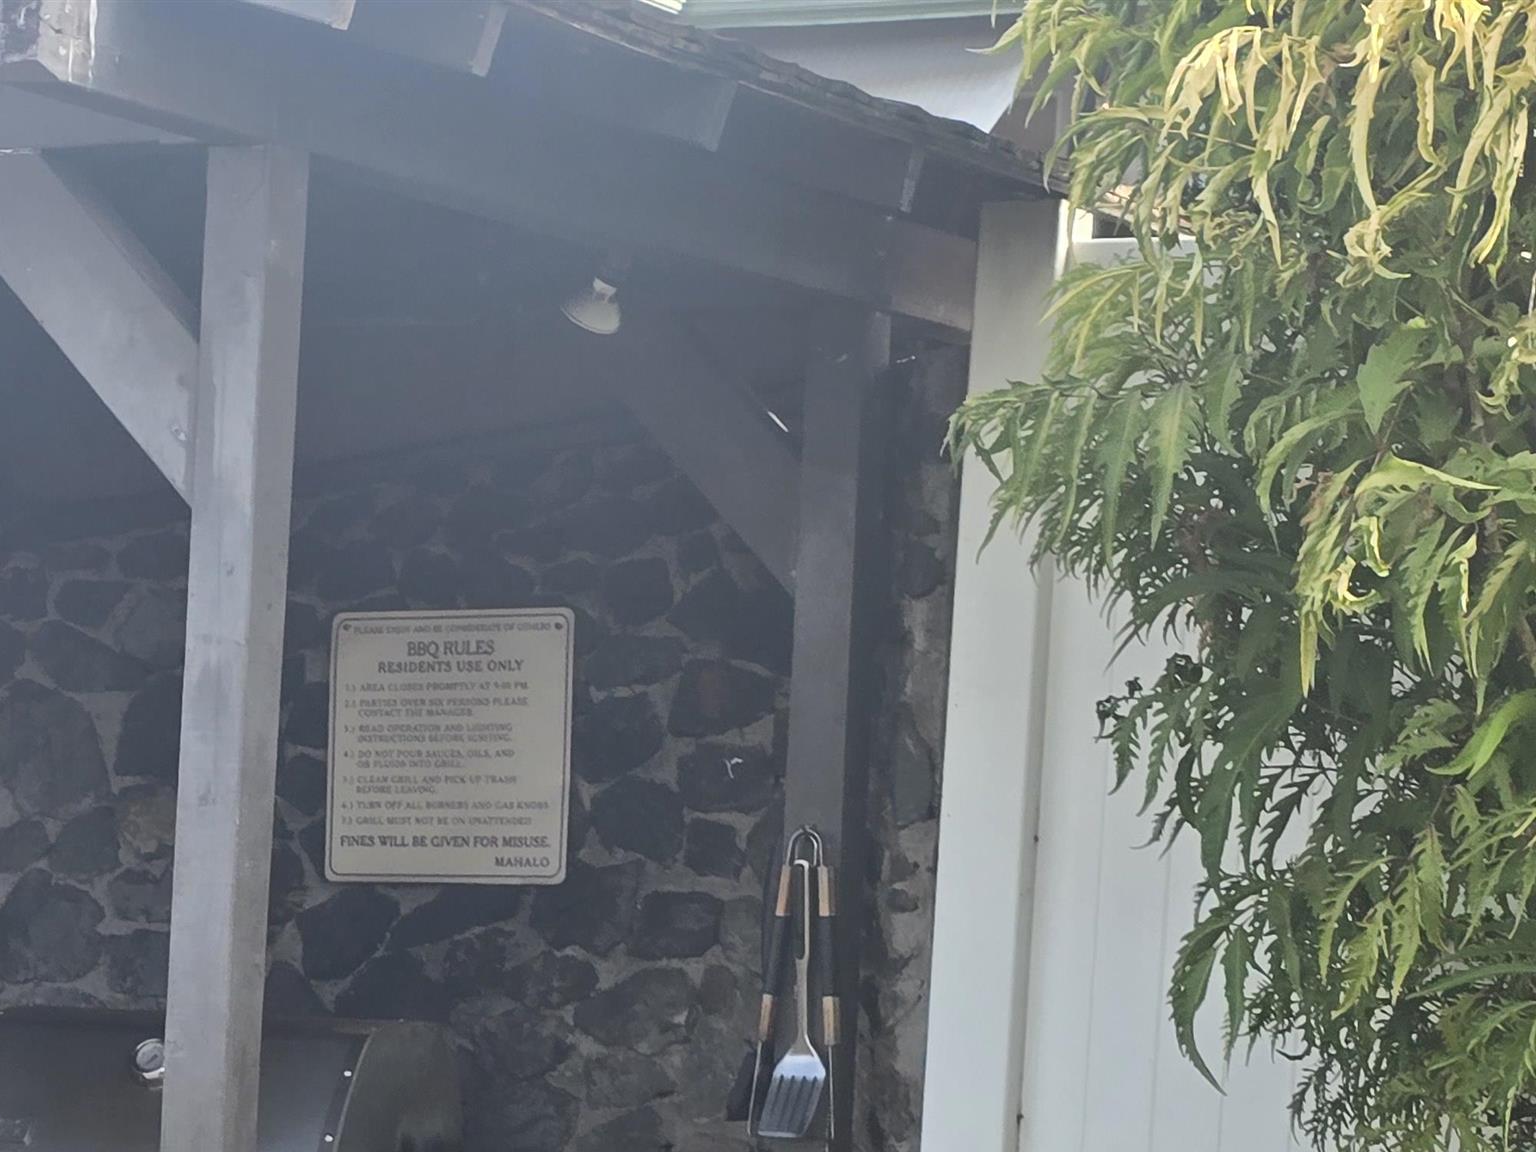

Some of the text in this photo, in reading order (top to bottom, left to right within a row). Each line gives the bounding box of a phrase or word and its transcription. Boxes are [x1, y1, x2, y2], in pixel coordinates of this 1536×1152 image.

[407, 639, 494, 658] BBQ RULES
[378, 659, 524, 673] RESIDENTS USE ONLY
[492, 697, 528, 705] PLEASE
[358, 709, 402, 717] CONTACT
[405, 709, 423, 717] THE
[444, 723, 464, 731] AND
[358, 750, 372, 758] DO
[375, 750, 395, 758] NOT
[397, 750, 423, 758] POUR
[495, 749, 515, 757] AND
[357, 776, 389, 784] CLEAN
[422, 775, 442, 783] AND
[468, 775, 482, 783] UP
[357, 801, 382, 809] TURN
[384, 801, 402, 809] OFF
[404, 801, 424, 809] ALL
[471, 801, 493, 809] AND
[356, 817, 384, 825] GRILL
[414, 817, 434, 825] NOT
[436, 817, 449, 825] BE
[451, 817, 466, 825] ON
[340, 835, 551, 847] FINES WILL BE GIVEN FOR MISUSE.
[494, 856, 550, 867] MAHALO
